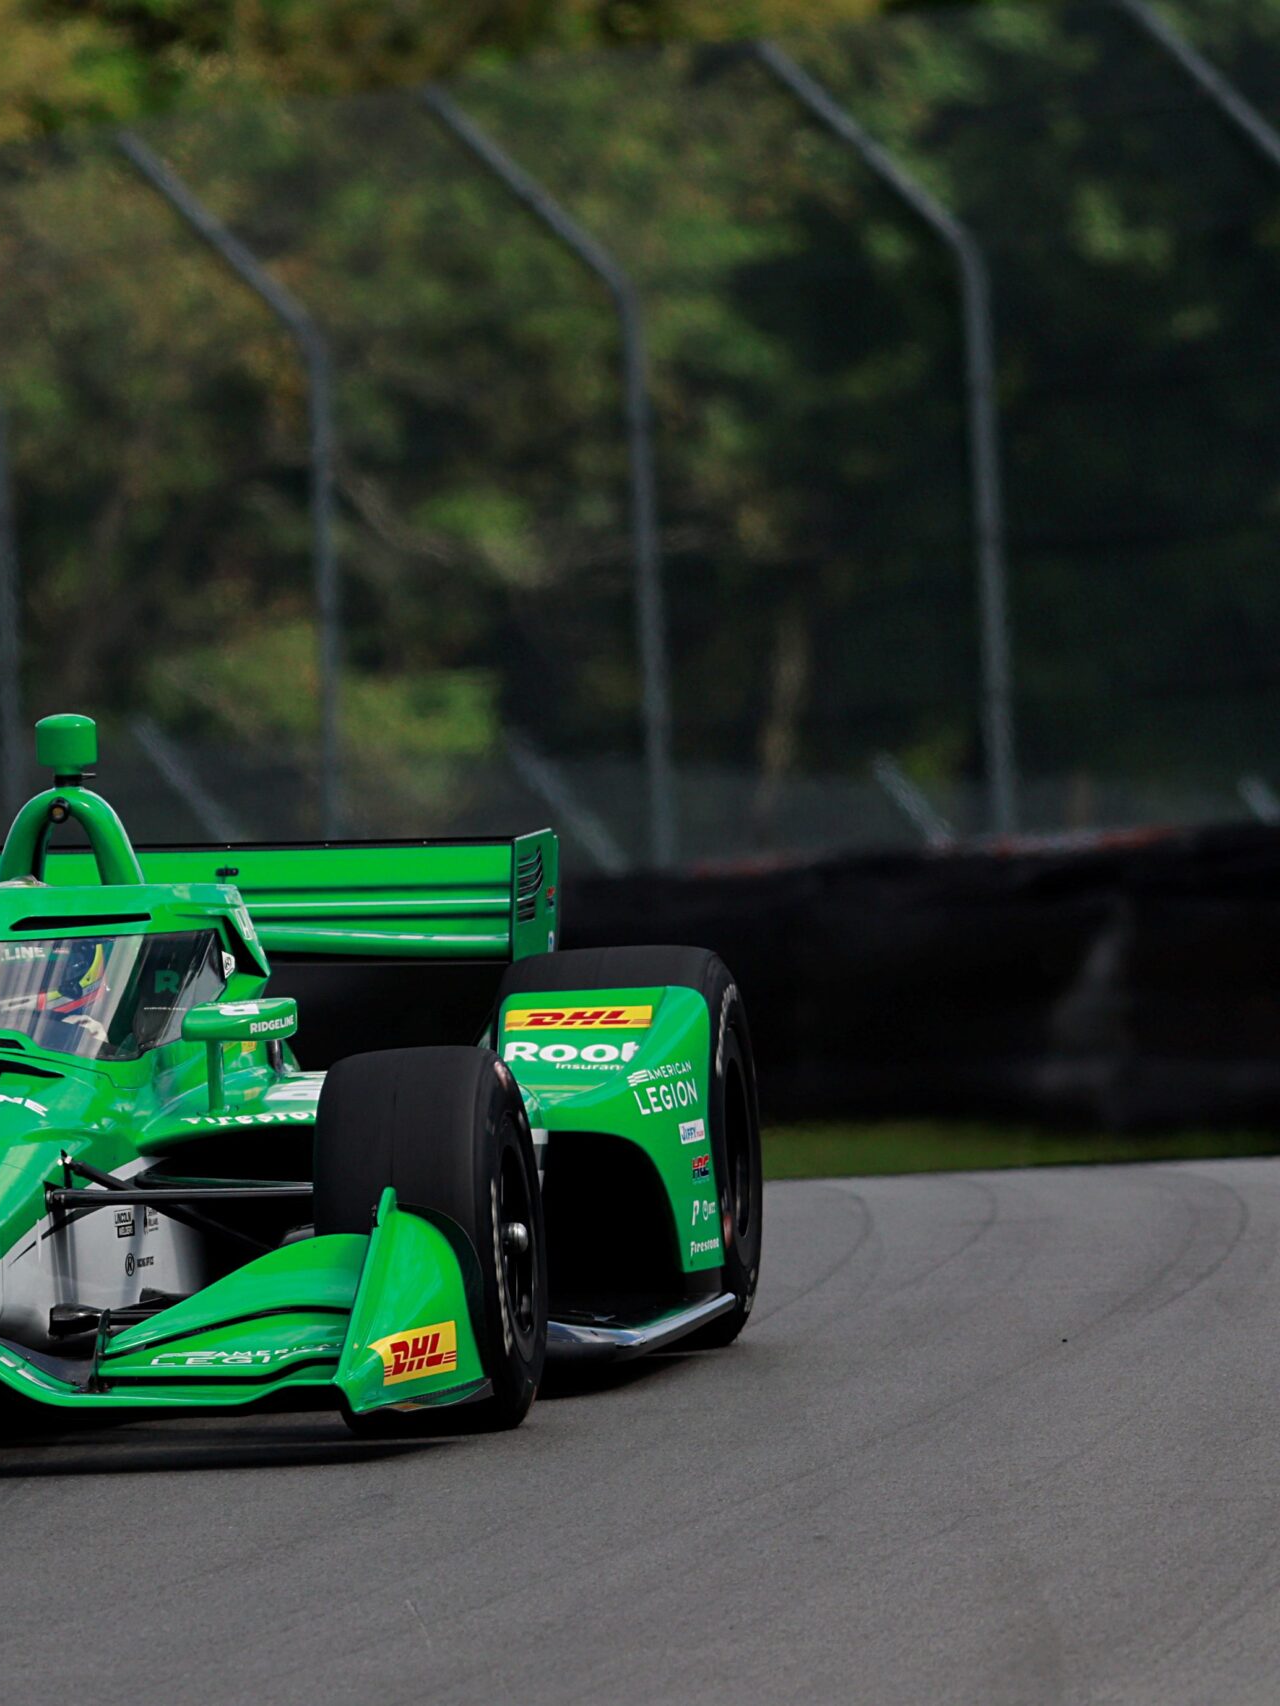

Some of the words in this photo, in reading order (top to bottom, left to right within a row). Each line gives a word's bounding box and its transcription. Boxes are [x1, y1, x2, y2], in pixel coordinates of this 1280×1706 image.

[250, 1014, 295, 1034] RIDGELINE
[524, 1010, 631, 1027] DHL
[555, 1062, 624, 1071] Insuran
[648, 1060, 692, 1081] AMERICAN
[633, 1078, 698, 1115] LEGION
[690, 1238, 719, 1257] Firestone
[390, 1332, 444, 1376] DHL
